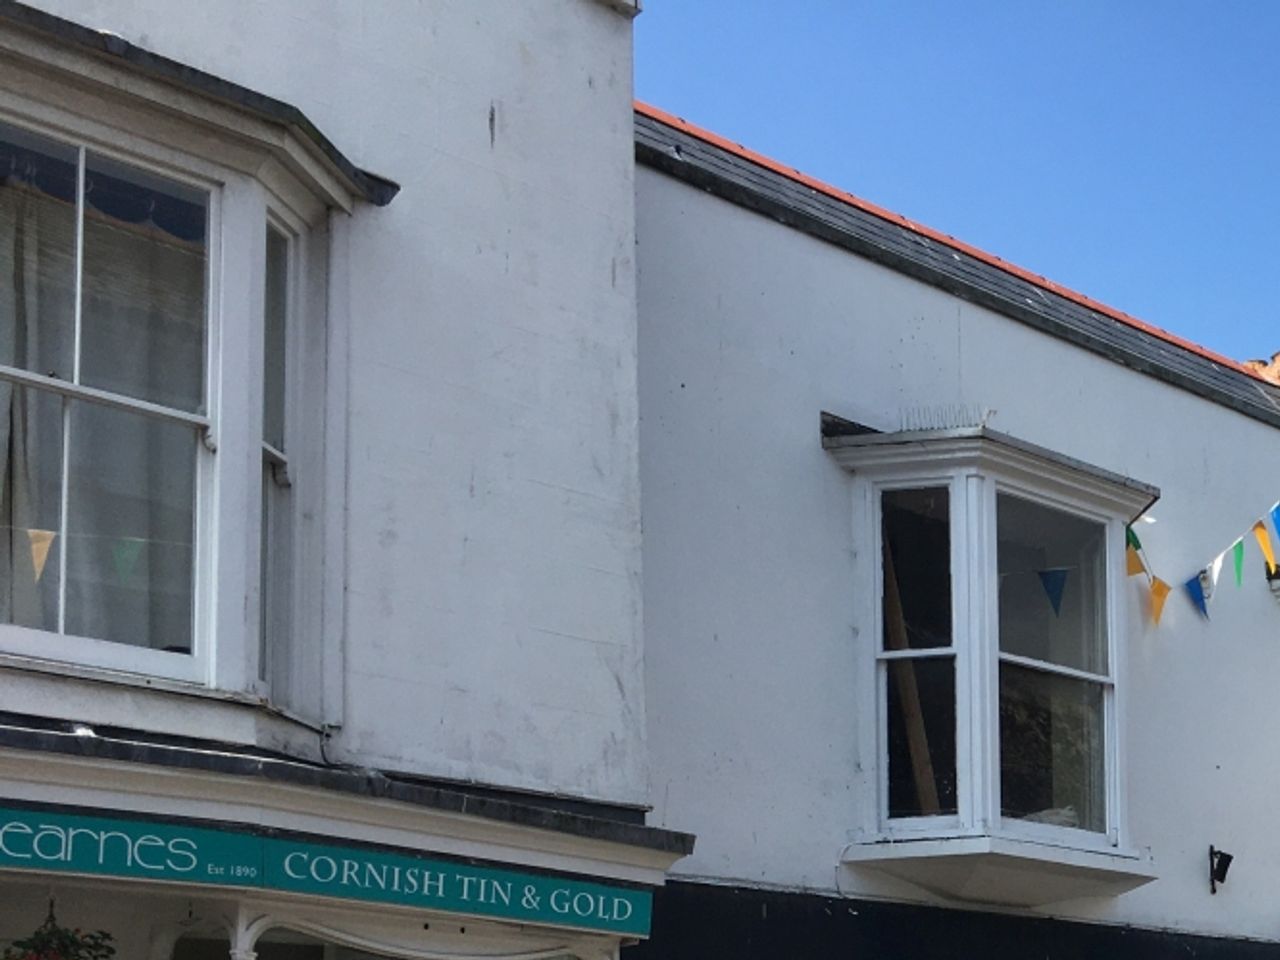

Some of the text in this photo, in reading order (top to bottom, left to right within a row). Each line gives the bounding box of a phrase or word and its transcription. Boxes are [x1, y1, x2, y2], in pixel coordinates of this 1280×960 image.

[230, 865, 257, 877] 1890
[284, 852, 633, 922] CORNISH TIN & GOLD
